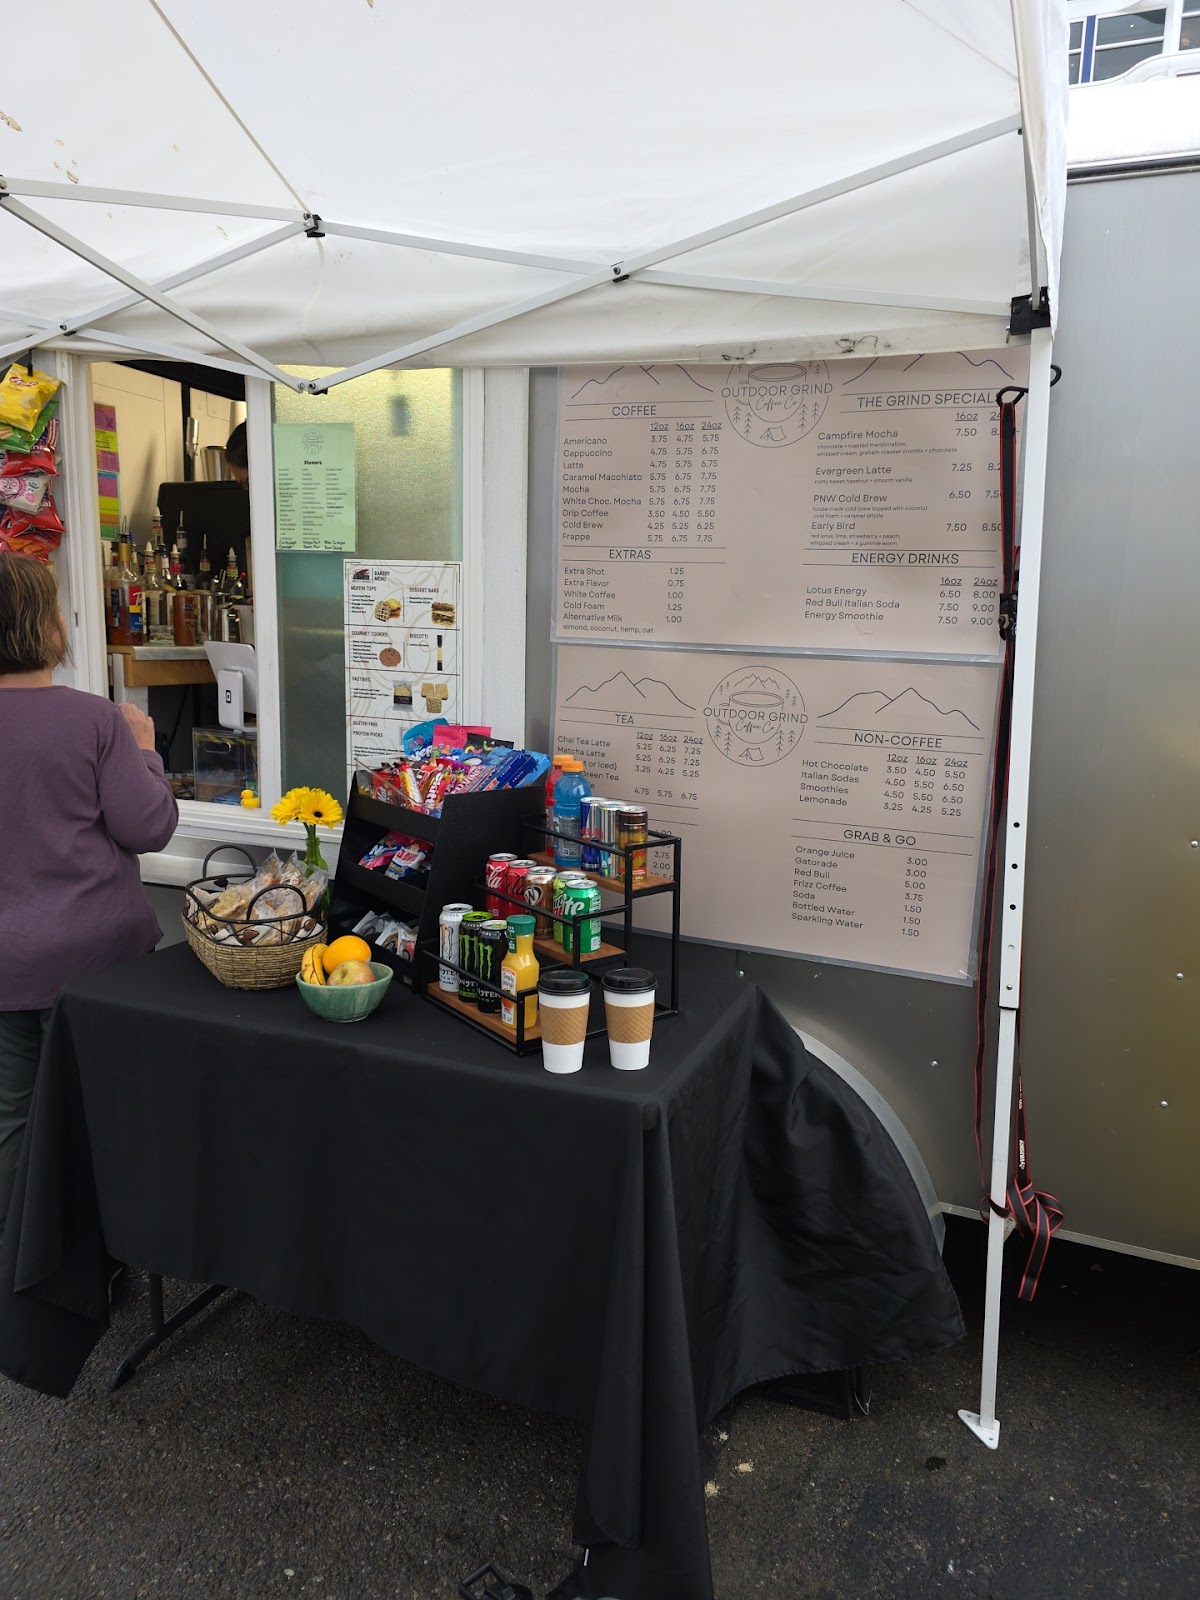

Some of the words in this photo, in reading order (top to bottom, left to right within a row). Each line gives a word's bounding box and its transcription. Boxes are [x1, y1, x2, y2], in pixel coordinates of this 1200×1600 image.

[721, 386, 786, 398] OUTDOOR
[791, 383, 833, 394] GRIND
[857, 396, 881, 408] THE
[886, 394, 930, 406] GRIND
[935, 393, 998, 404] SPECIAL
[612, 405, 657, 416] COFFEE
[955, 412, 978, 421] 16oz
[650, 423, 668, 431] 12oz
[676, 422, 694, 430] 16oz
[701, 422, 722, 430] 24oz
[702, 434, 719, 442] 5.75
[818, 431, 863, 441] Campfire
[866, 430, 898, 439] Mocha
[956, 428, 977, 437] 7.50
[563, 450, 612, 458] Cappuccino
[816, 467, 863, 477] Evergreen
[866, 466, 891, 474] Latte
[813, 495, 836, 503] PNW
[838, 495, 861, 503] Cold
[863, 494, 887, 502] Brew
[949, 491, 971, 499] 6.50
[563, 510, 579, 518] Drip
[811, 522, 834, 531] Early
[837, 522, 855, 530] Bird
[946, 523, 967, 531] 7.50
[563, 533, 590, 542] Frappe
[609, 550, 651, 559] EXTRAS
[852, 553, 905, 563] ENERGY
[908, 553, 959, 564] DRINKS
[940, 577, 962, 586] 16oz
[973, 577, 998, 587] 24oz
[589, 591, 615, 599] Coffee
[806, 586, 832, 594] Lotus
[835, 587, 867, 596] Energy
[940, 590, 960, 598] 6.50
[973, 591, 995, 599] 8.00
[806, 599, 823, 607] Red
[826, 599, 842, 607] Bull
[845, 600, 873, 608] Italian
[876, 600, 900, 608] Soda
[805, 611, 836, 620] Energy
[838, 612, 884, 620] Smoothie
[615, 714, 634, 724] TEA
[703, 707, 765, 720] OUTDOOR
[769, 712, 808, 724] GRIND
[636, 732, 653, 740] 12oz
[659, 734, 677, 742] 16oz
[683, 736, 703, 744] 24oz
[854, 733, 942, 748] NON-COFFEE
[557, 746, 584, 755] Matcha
[586, 750, 605, 758] Latte
[660, 745, 676, 753] 6.25
[684, 747, 700, 755] 7.25
[598, 762, 617, 770] iced)
[887, 754, 908, 763] 12oz
[916, 756, 937, 765] 16oz
[944, 758, 968, 768] 24oz
[802, 760, 817, 768] Hot
[821, 761, 868, 772] Chocolate
[887, 766, 906, 774] 3.50
[915, 768, 935, 777] 4.50
[945, 771, 965, 779] 5.50
[606, 773, 618, 781] Tea
[801, 772, 828, 781] Italian
[831, 774, 859, 783] Sodas
[800, 783, 849, 794] Smoothies
[799, 795, 847, 806] Lemonade
[843, 829, 879, 842] GRAB
[883, 834, 891, 843] &
[895, 835, 916, 846] GO
[655, 851, 669, 859] 3.75
[796, 846, 829, 857] Orange
[831, 850, 855, 859] Juice
[907, 857, 927, 866] 3.00
[653, 862, 670, 870] 2.00
[795, 857, 838, 868] Gatorade
[795, 868, 812, 876] Red
[814, 870, 830, 879] Bull
[905, 881, 925, 890] 5.00
[794, 880, 814, 889] Frizz
[816, 882, 847, 892] Coffee
[793, 891, 815, 900] Soda
[792, 902, 825, 912] Bottled
[827, 906, 855, 916] Water
[792, 913, 833, 926] Sparkling
[836, 919, 863, 929] Water
